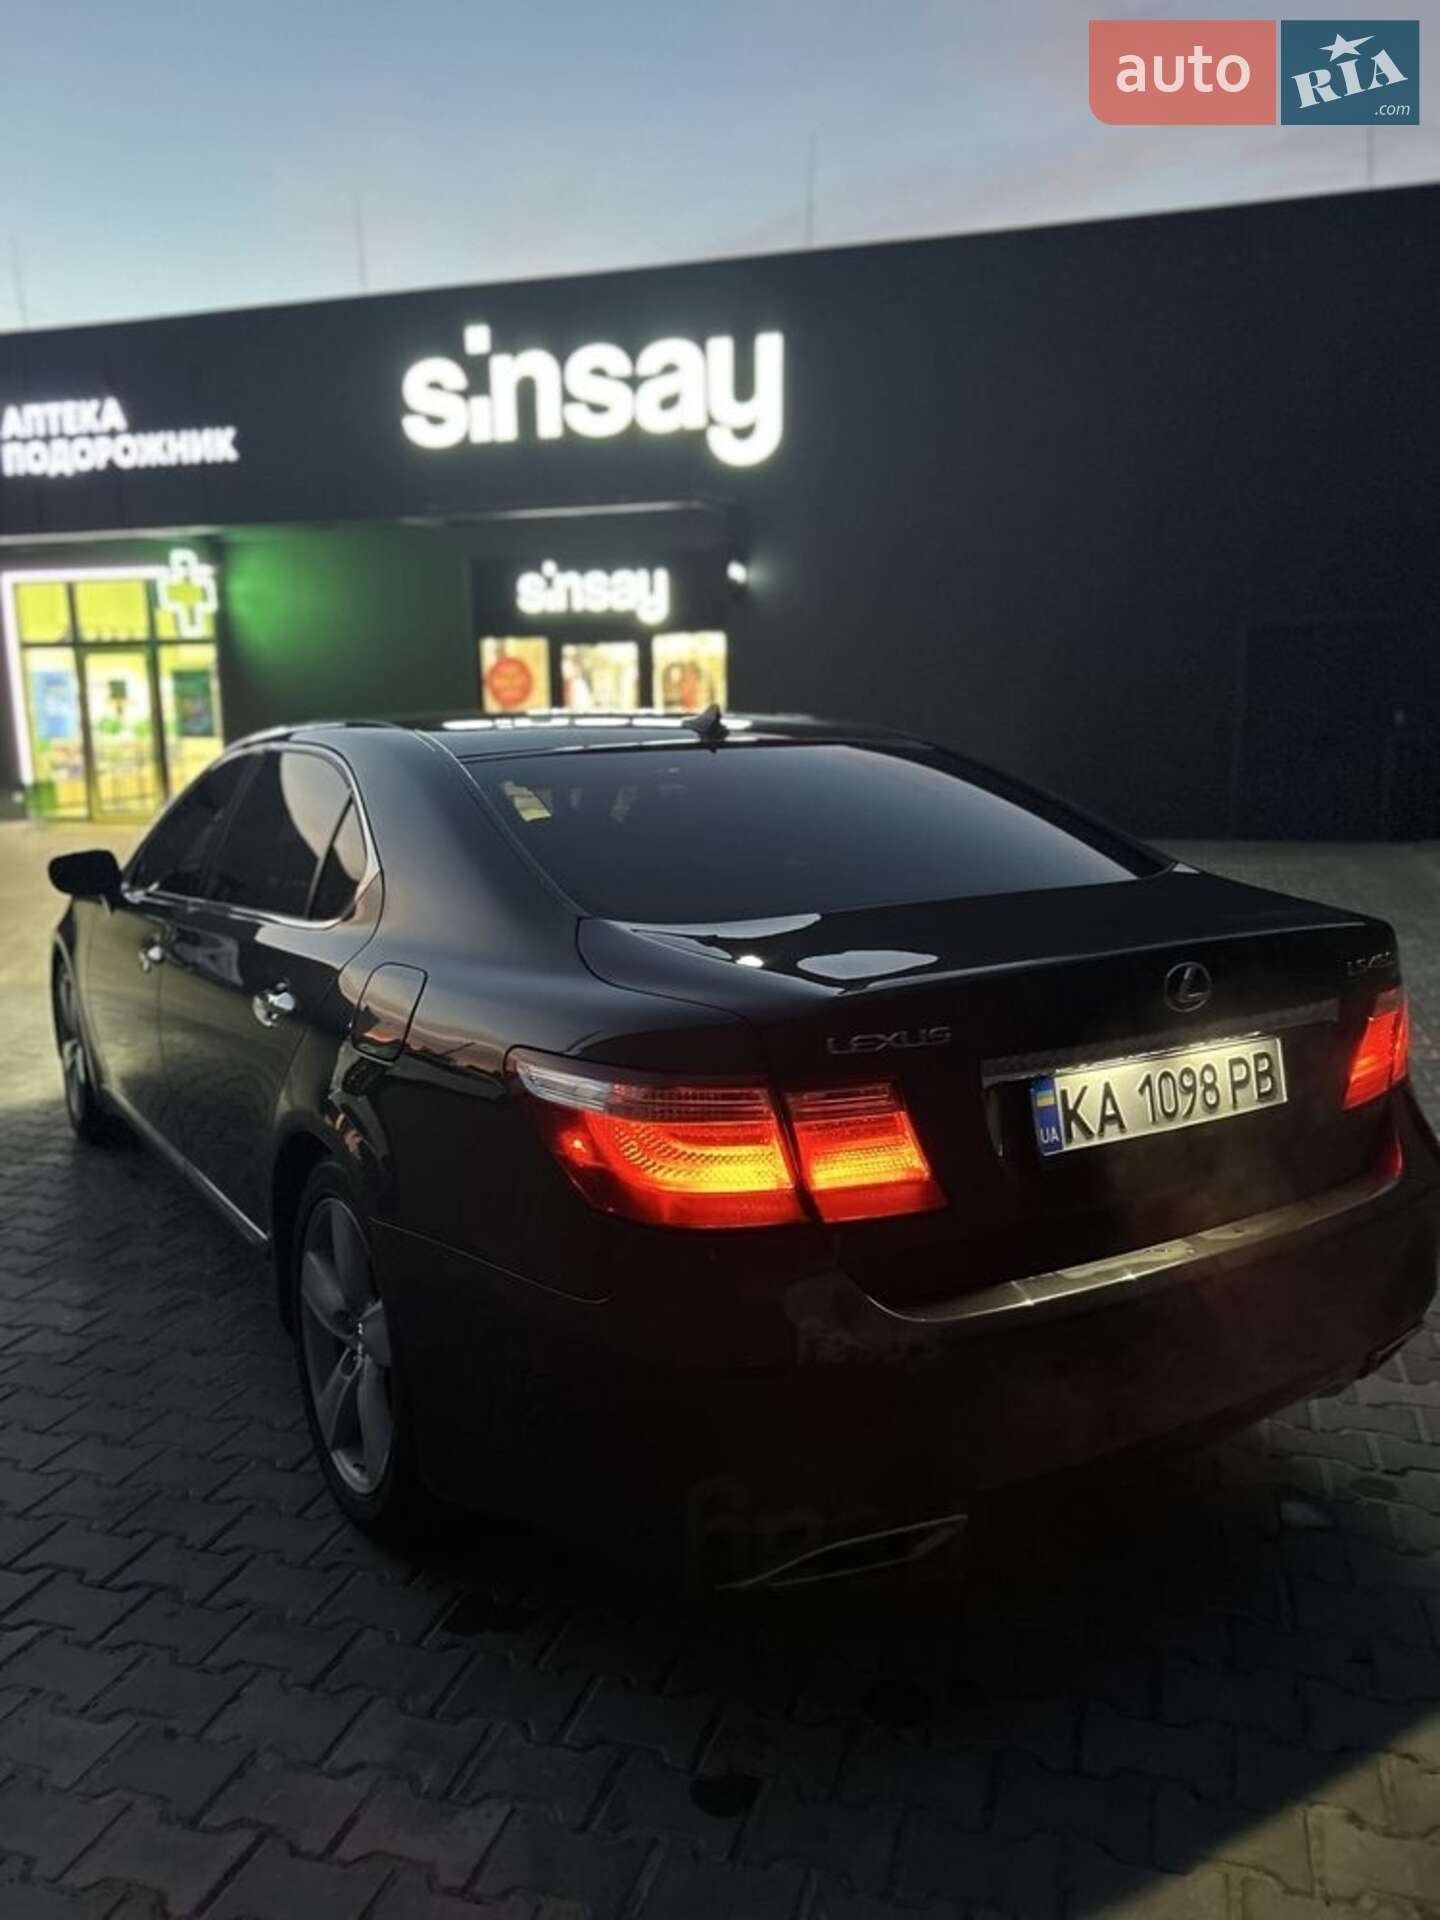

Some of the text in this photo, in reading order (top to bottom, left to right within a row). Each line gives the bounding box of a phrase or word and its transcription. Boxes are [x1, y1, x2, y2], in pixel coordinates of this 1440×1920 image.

[1, 396, 128, 440] АПТЕКА
[402, 323, 784, 467] sinsay
[1, 426, 239, 477] ПОДОРОЖНИК
[516, 559, 670, 625] sinsay
[827, 1026, 952, 1054] LEXUS
[1060, 1051, 1276, 1145] KA 1098 PB
[1039, 1128, 1060, 1144] UA
